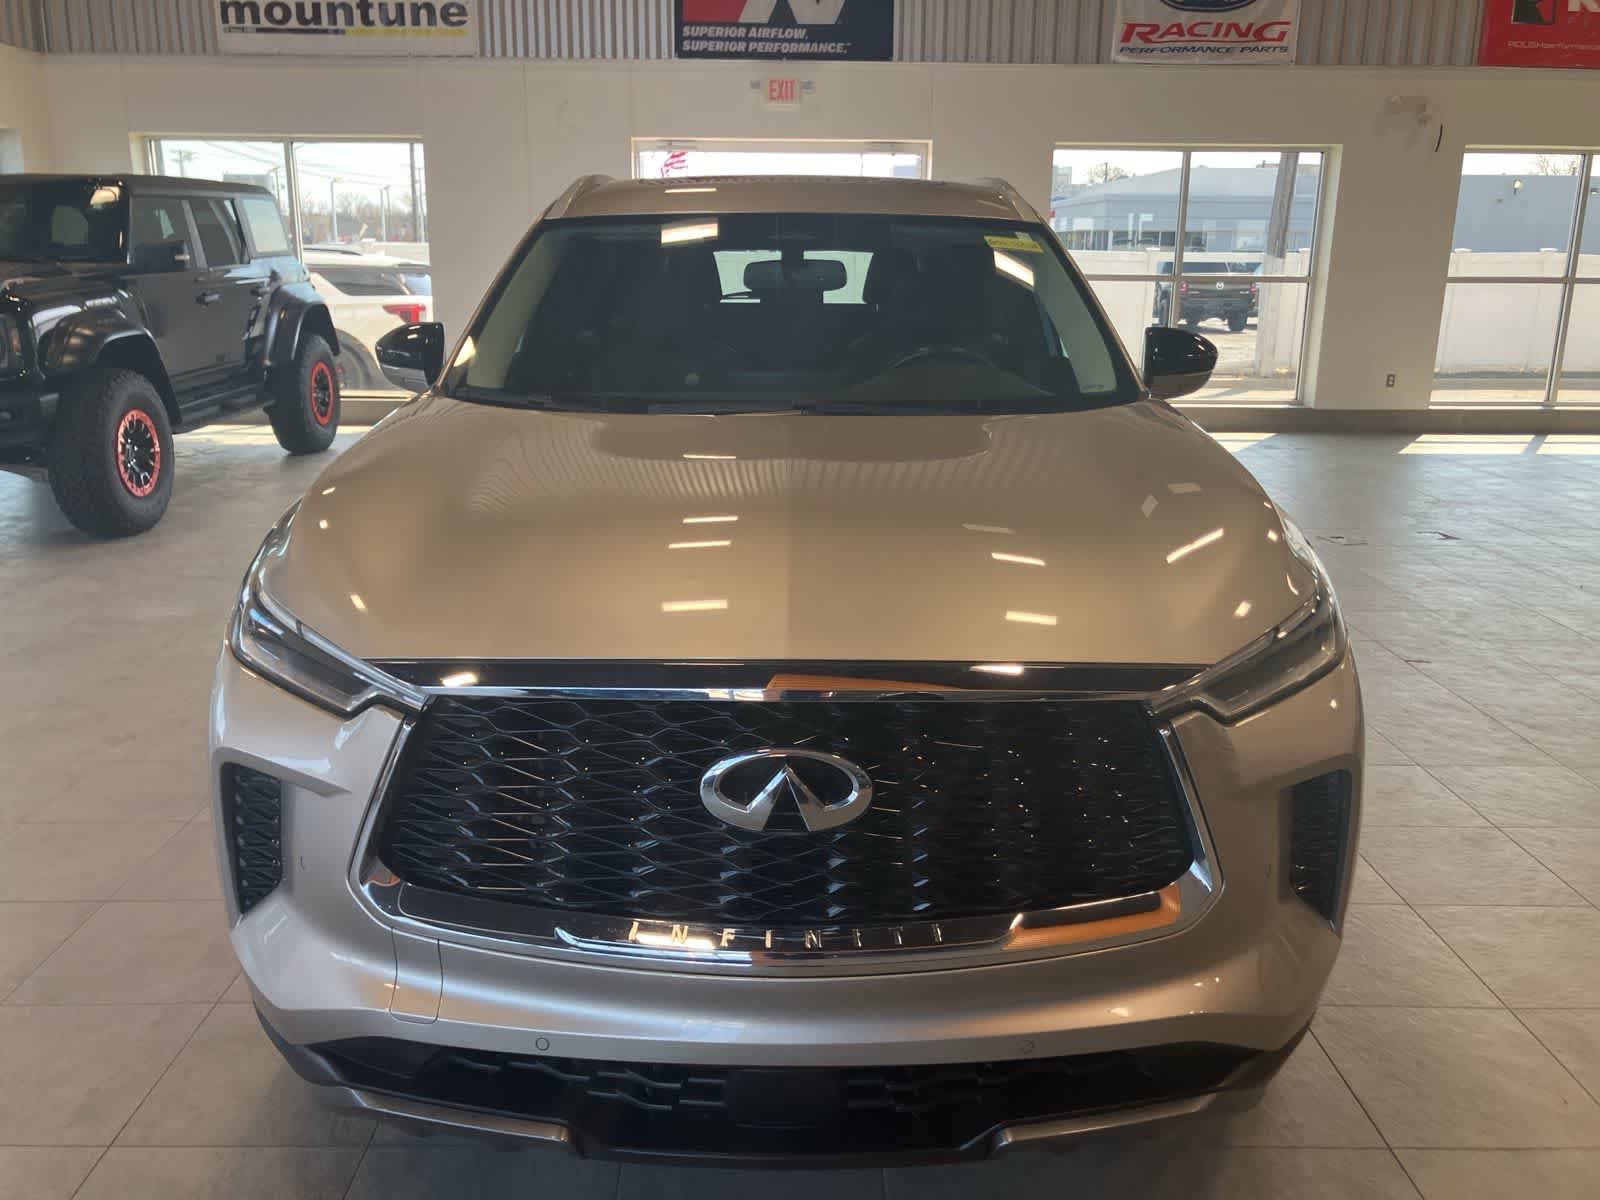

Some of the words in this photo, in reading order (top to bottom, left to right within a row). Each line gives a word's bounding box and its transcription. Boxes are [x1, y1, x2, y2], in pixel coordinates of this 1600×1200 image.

[220, 0, 468, 27] mountune
[682, 26, 746, 38] SUPERIOR
[1120, 22, 1291, 43] RACING
[682, 40, 746, 52] SUPERIOR
[1119, 46, 1233, 54] PERFORMANCE
[1239, 46, 1289, 54] PARTS
[768, 79, 796, 101] EXIT
[627, 920, 945, 949] INFINITI
